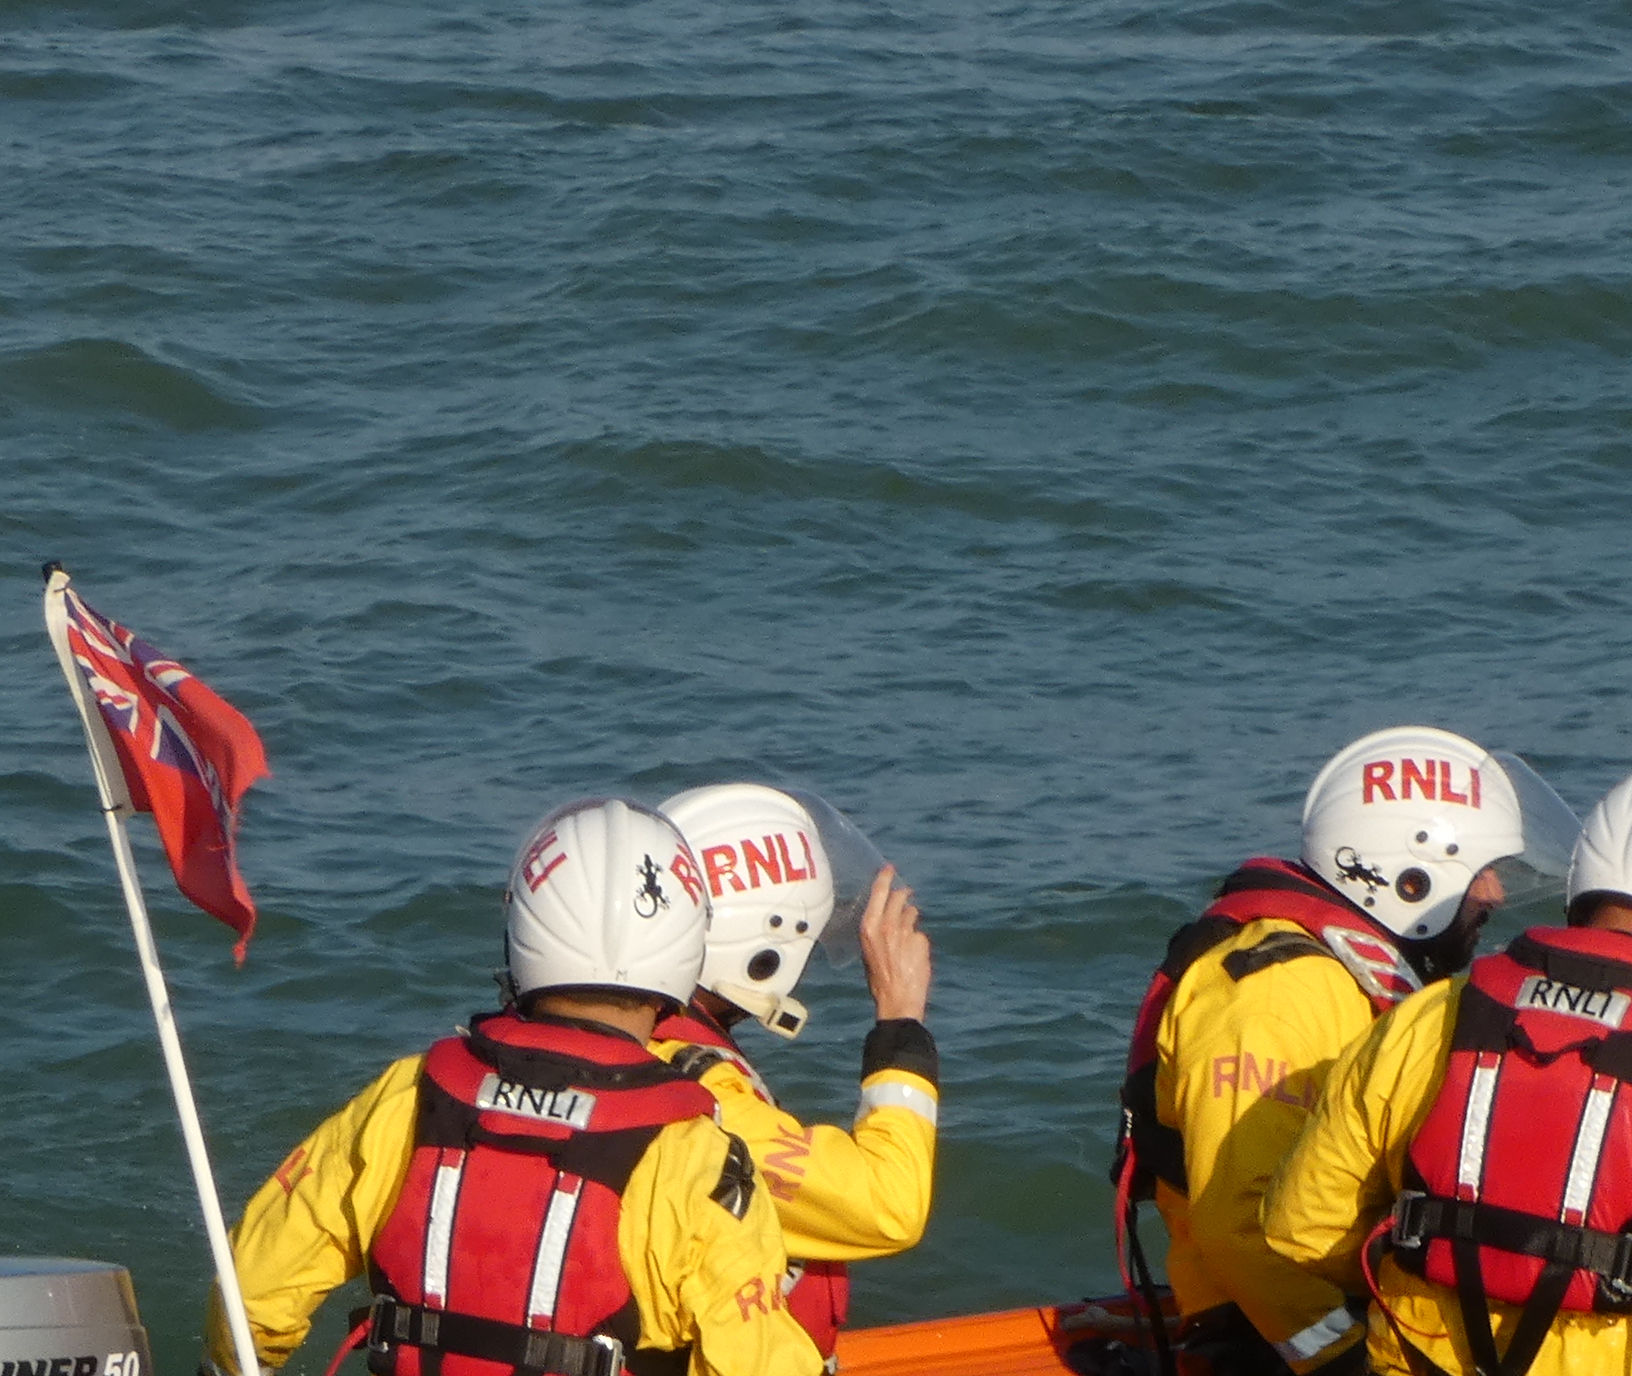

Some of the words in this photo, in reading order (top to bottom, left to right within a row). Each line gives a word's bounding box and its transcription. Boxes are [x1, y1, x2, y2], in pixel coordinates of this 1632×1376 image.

[1363, 758, 1481, 810] RNLI
[700, 830, 817, 898] RNLI
[1529, 979, 1612, 1019] RNLI
[492, 1079, 579, 1120] RNLI
[761, 1123, 814, 1202] RNL
